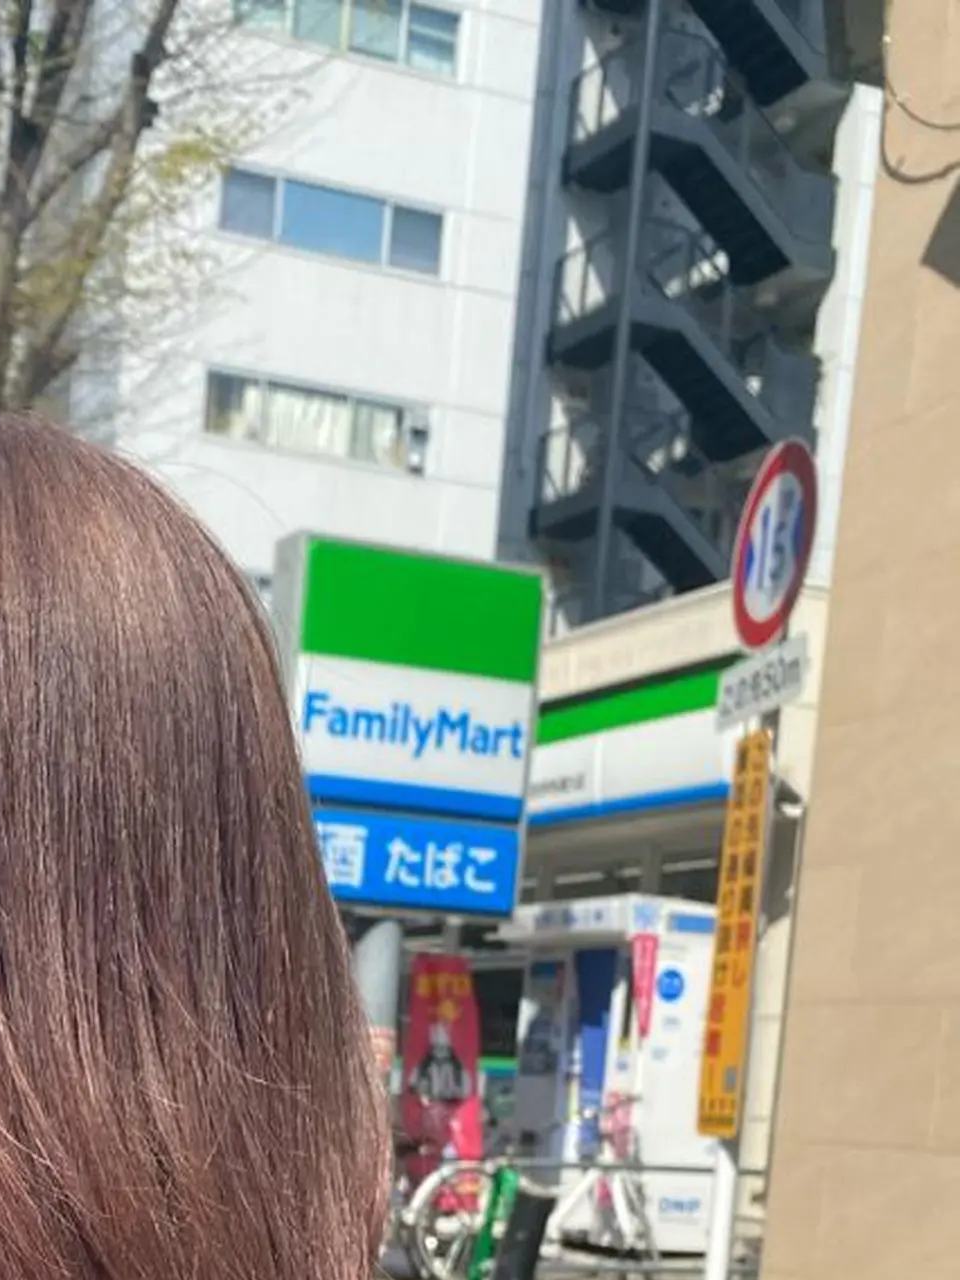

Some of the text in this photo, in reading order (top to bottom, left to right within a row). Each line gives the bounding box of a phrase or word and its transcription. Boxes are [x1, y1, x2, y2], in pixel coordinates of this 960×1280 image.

[303, 691, 522, 759] FamilyMart
[385, 837, 497, 893] たばこ
